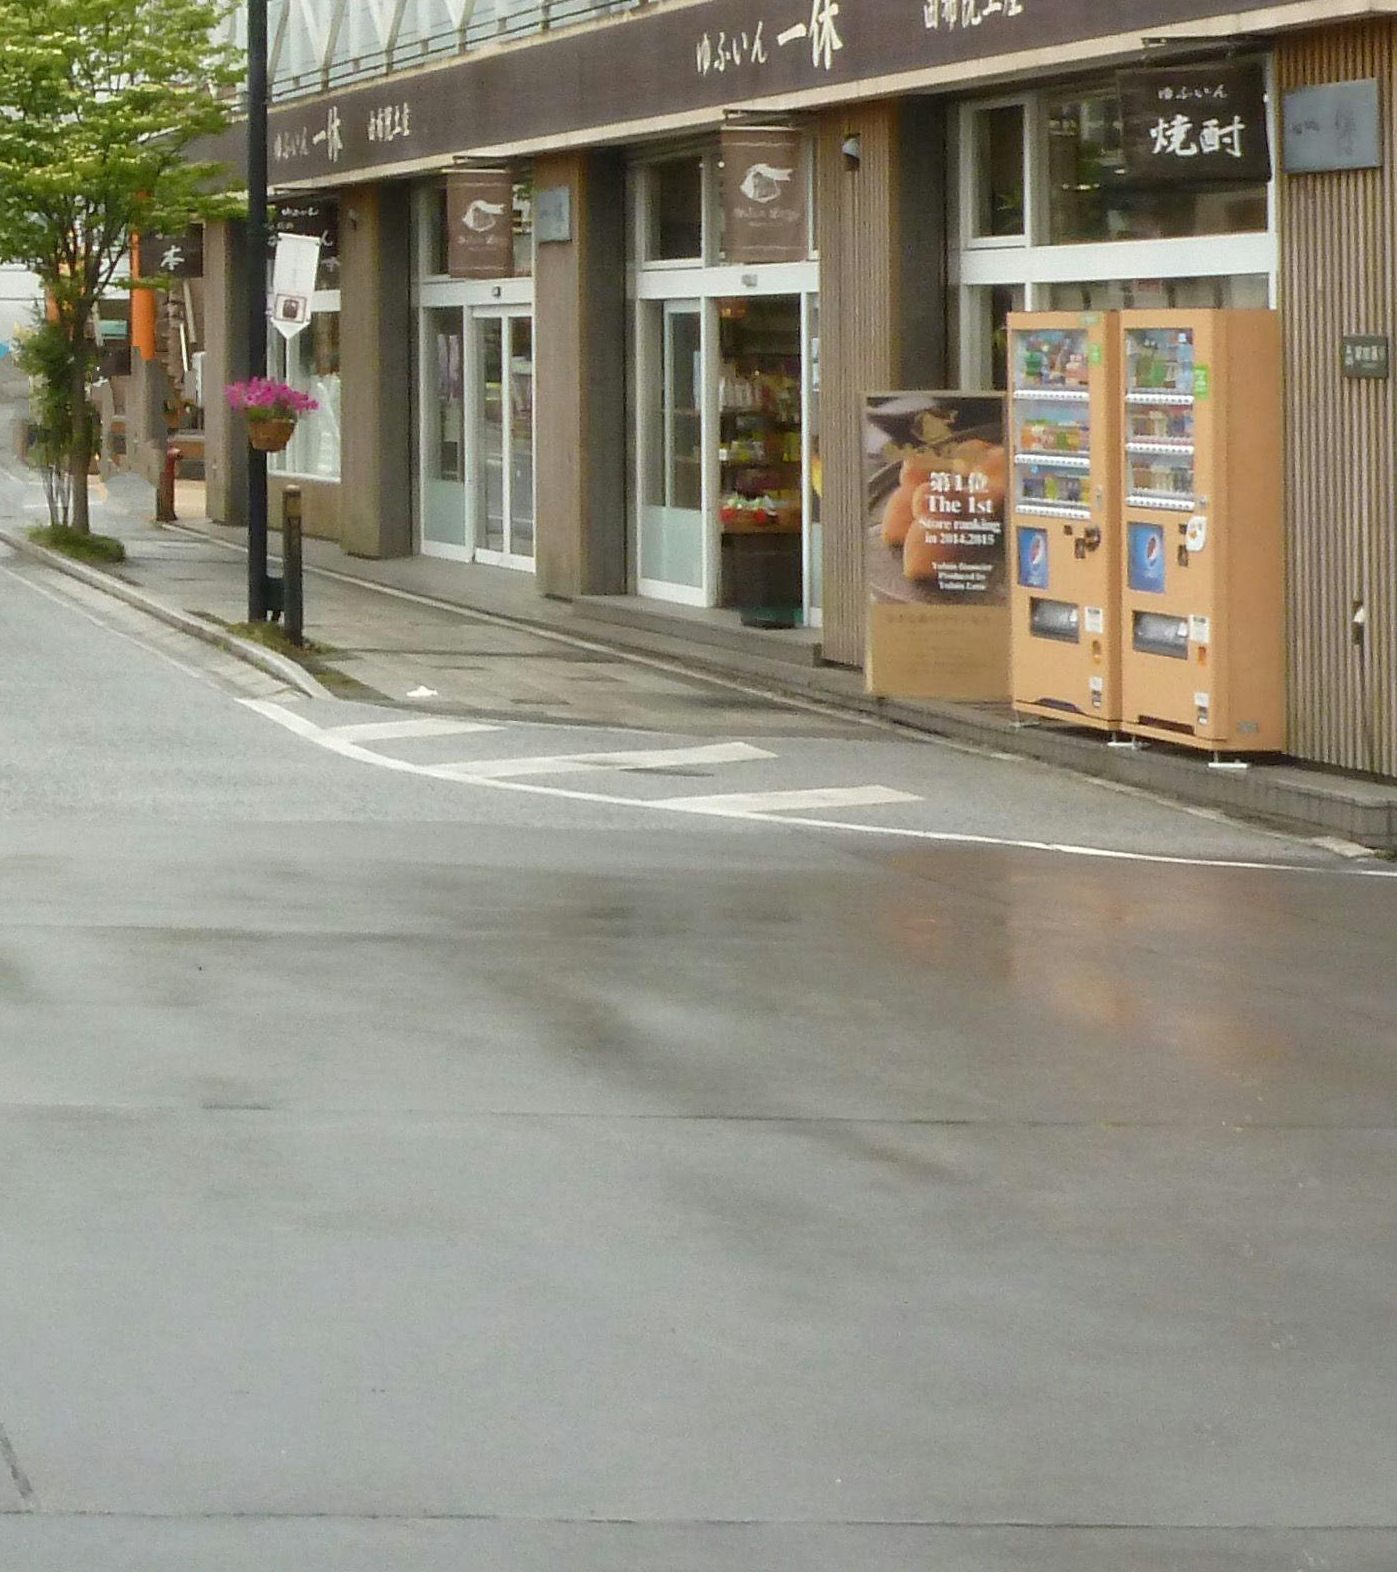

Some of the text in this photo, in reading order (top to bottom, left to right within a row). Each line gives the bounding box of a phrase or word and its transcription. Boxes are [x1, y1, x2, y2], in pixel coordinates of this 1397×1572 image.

[696, 21, 767, 75] ゆふいん
[1158, 84, 1228, 100] ゆふいん
[1150, 114, 1246, 158] 焼酎
[928, 495, 994, 514] The 1st
